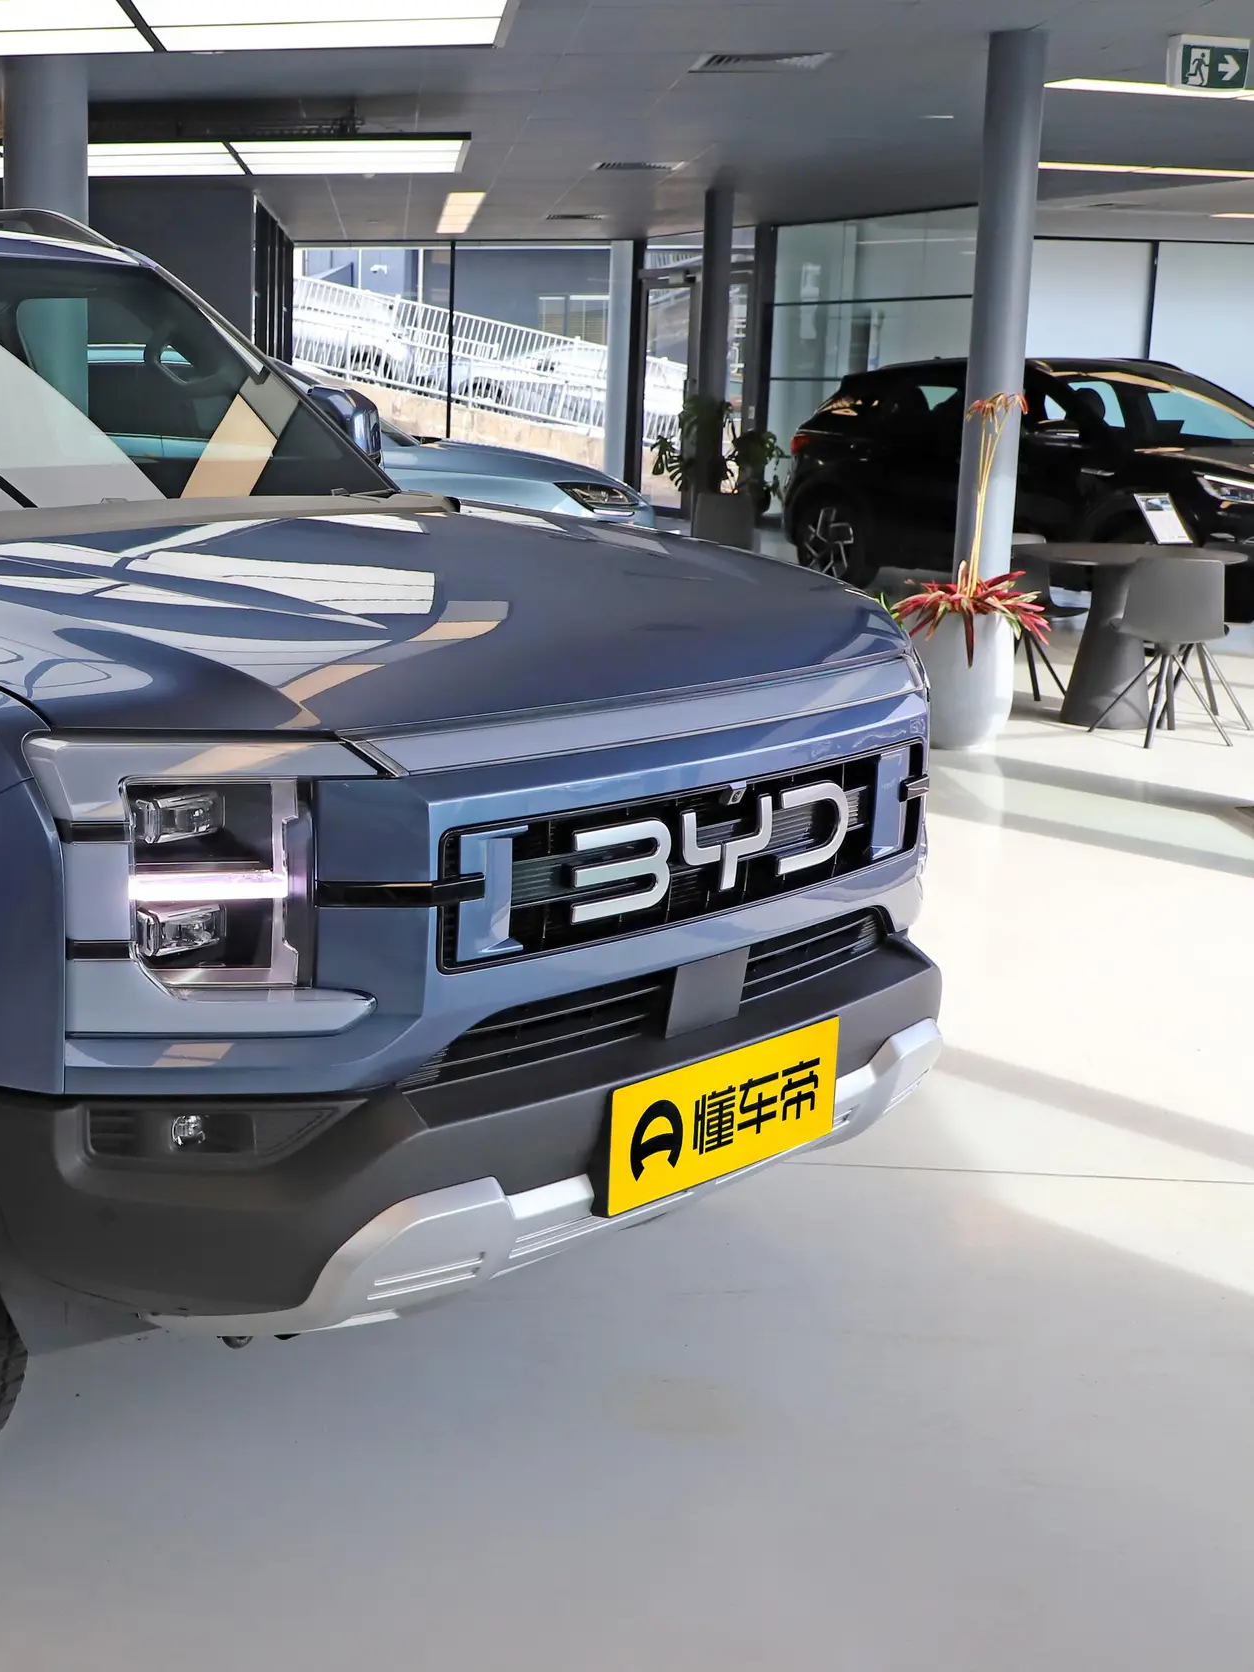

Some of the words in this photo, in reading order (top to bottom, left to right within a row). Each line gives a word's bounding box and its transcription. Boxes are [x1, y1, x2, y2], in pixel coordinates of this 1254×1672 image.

[570, 781, 849, 925] BYD
[692, 1057, 821, 1156] 懂车帝
